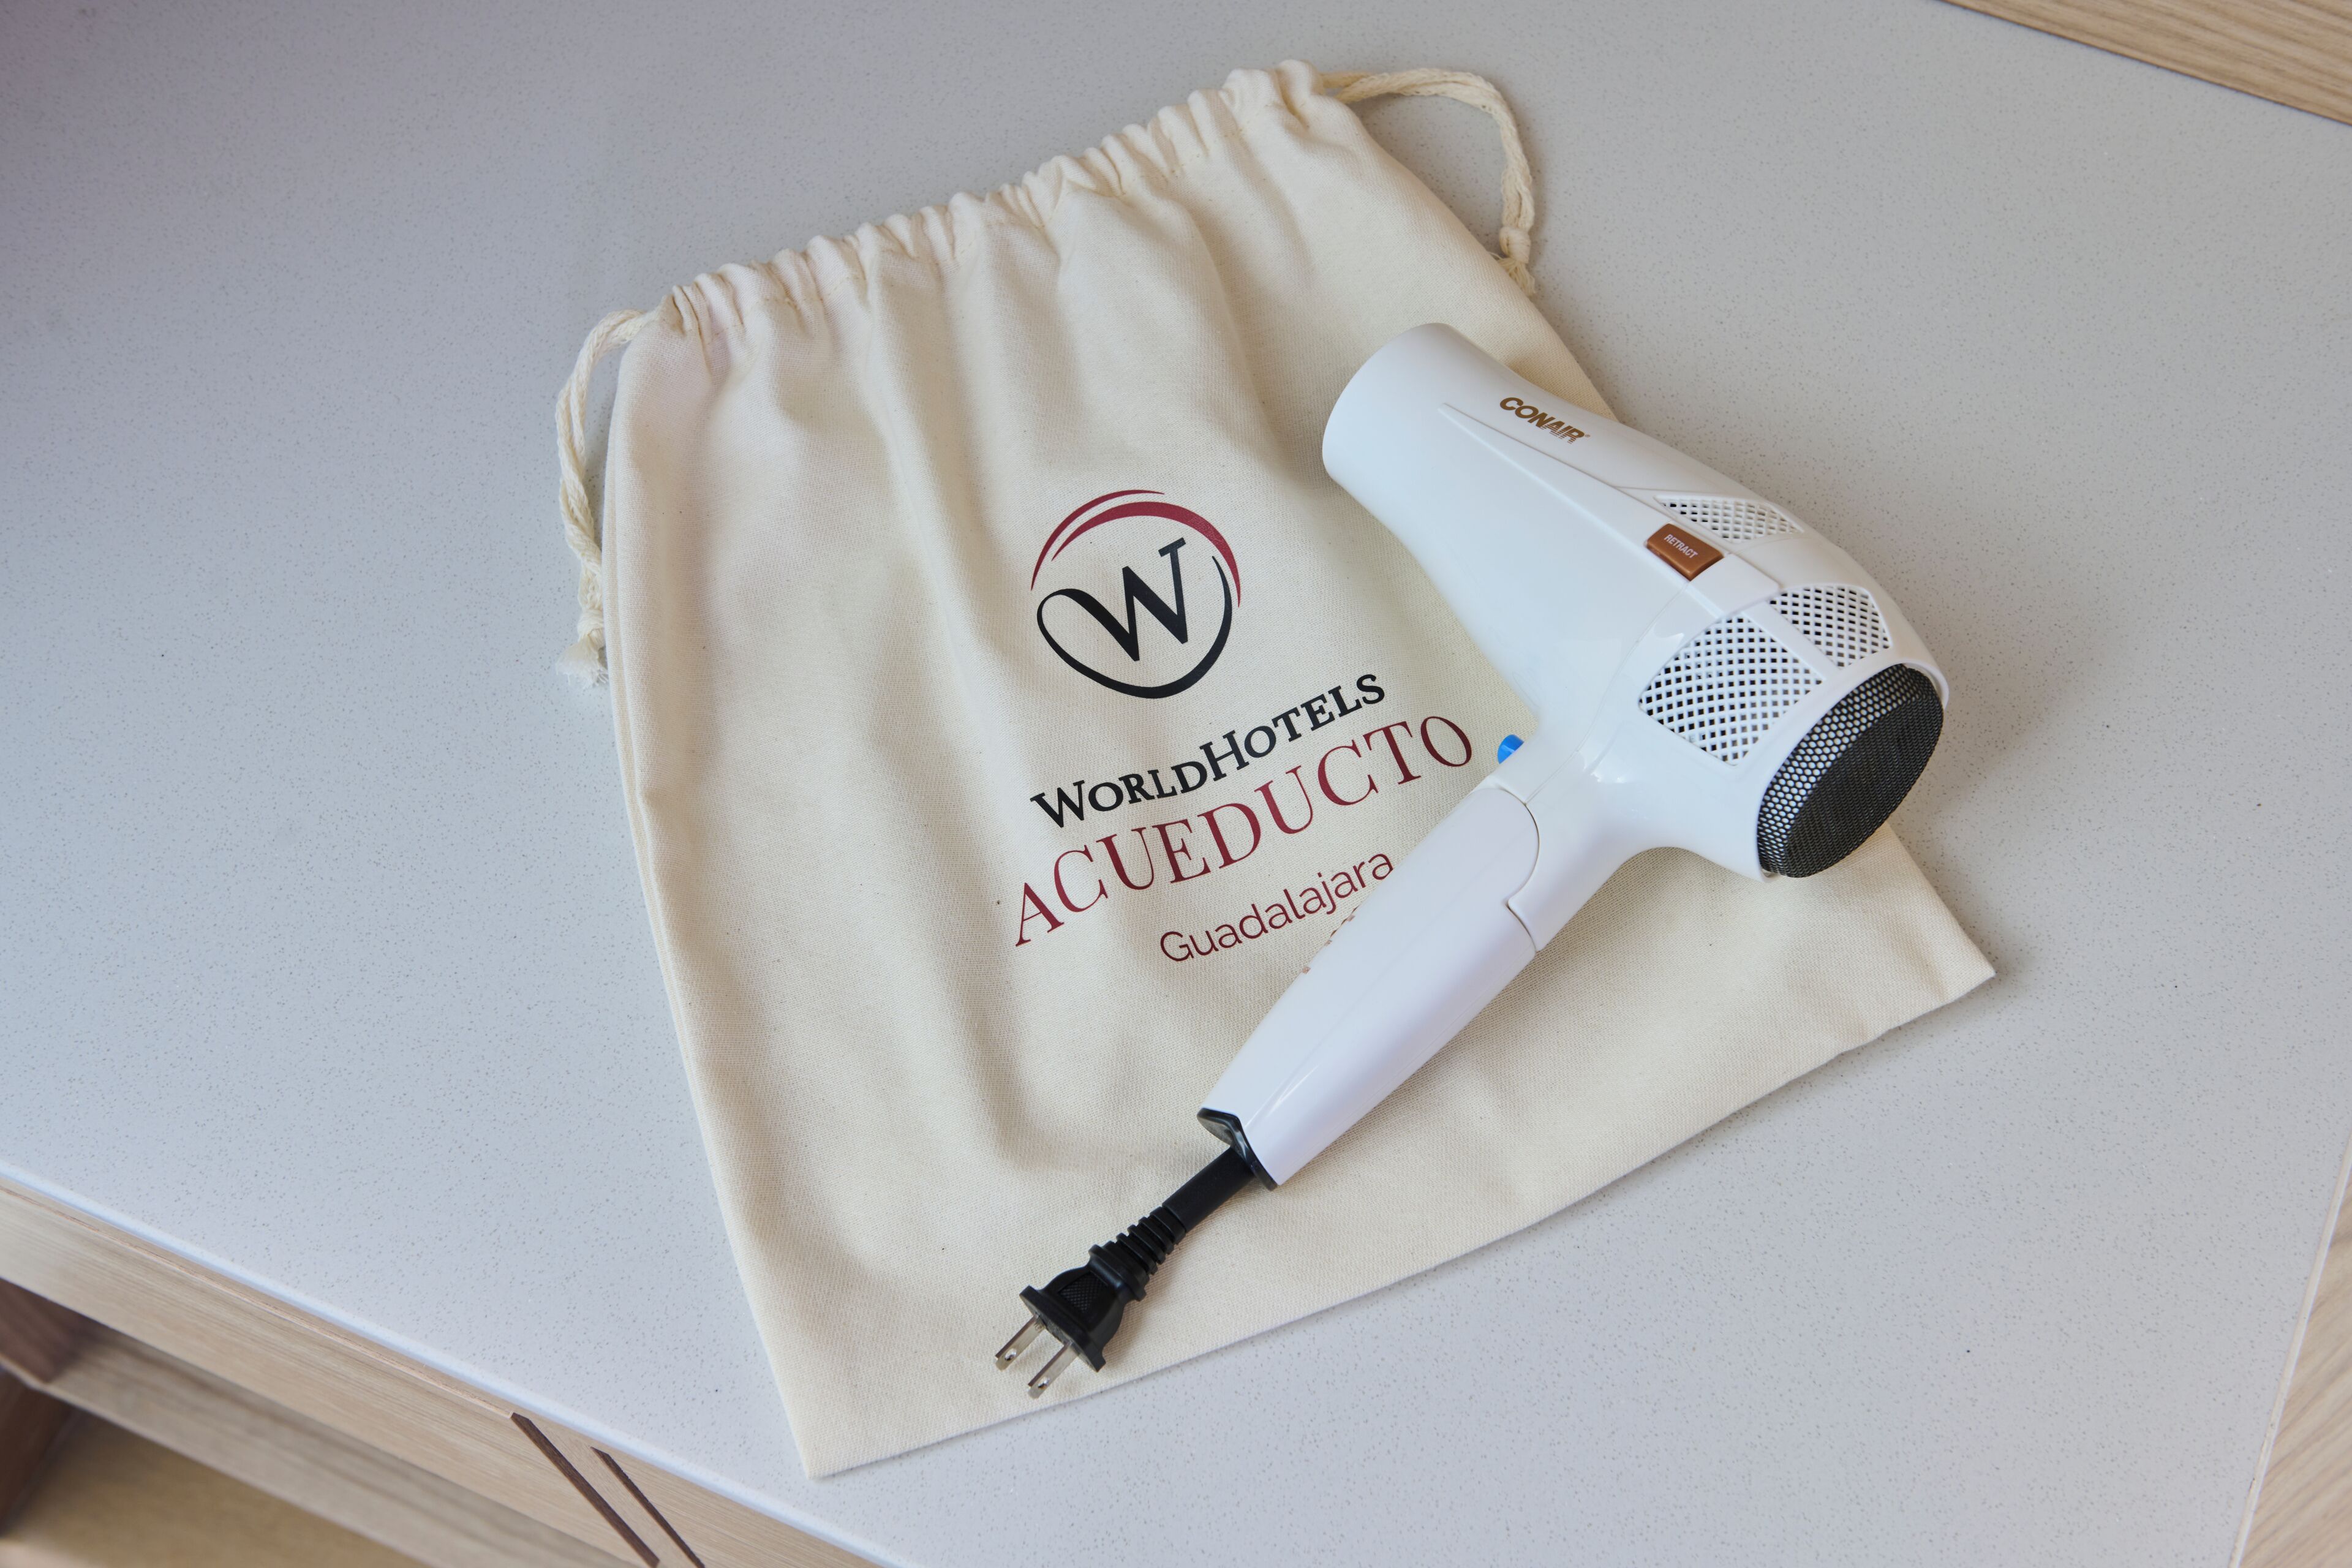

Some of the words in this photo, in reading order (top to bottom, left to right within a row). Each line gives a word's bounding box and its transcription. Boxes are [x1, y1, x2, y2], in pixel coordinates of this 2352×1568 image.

[1664, 534, 1698, 559] RETRACT
[1030, 674, 1385, 828] WORLDHOTELS
[1015, 715, 1472, 947] ACUEDUCTO
[1160, 853, 1393, 962] Guadalajara
